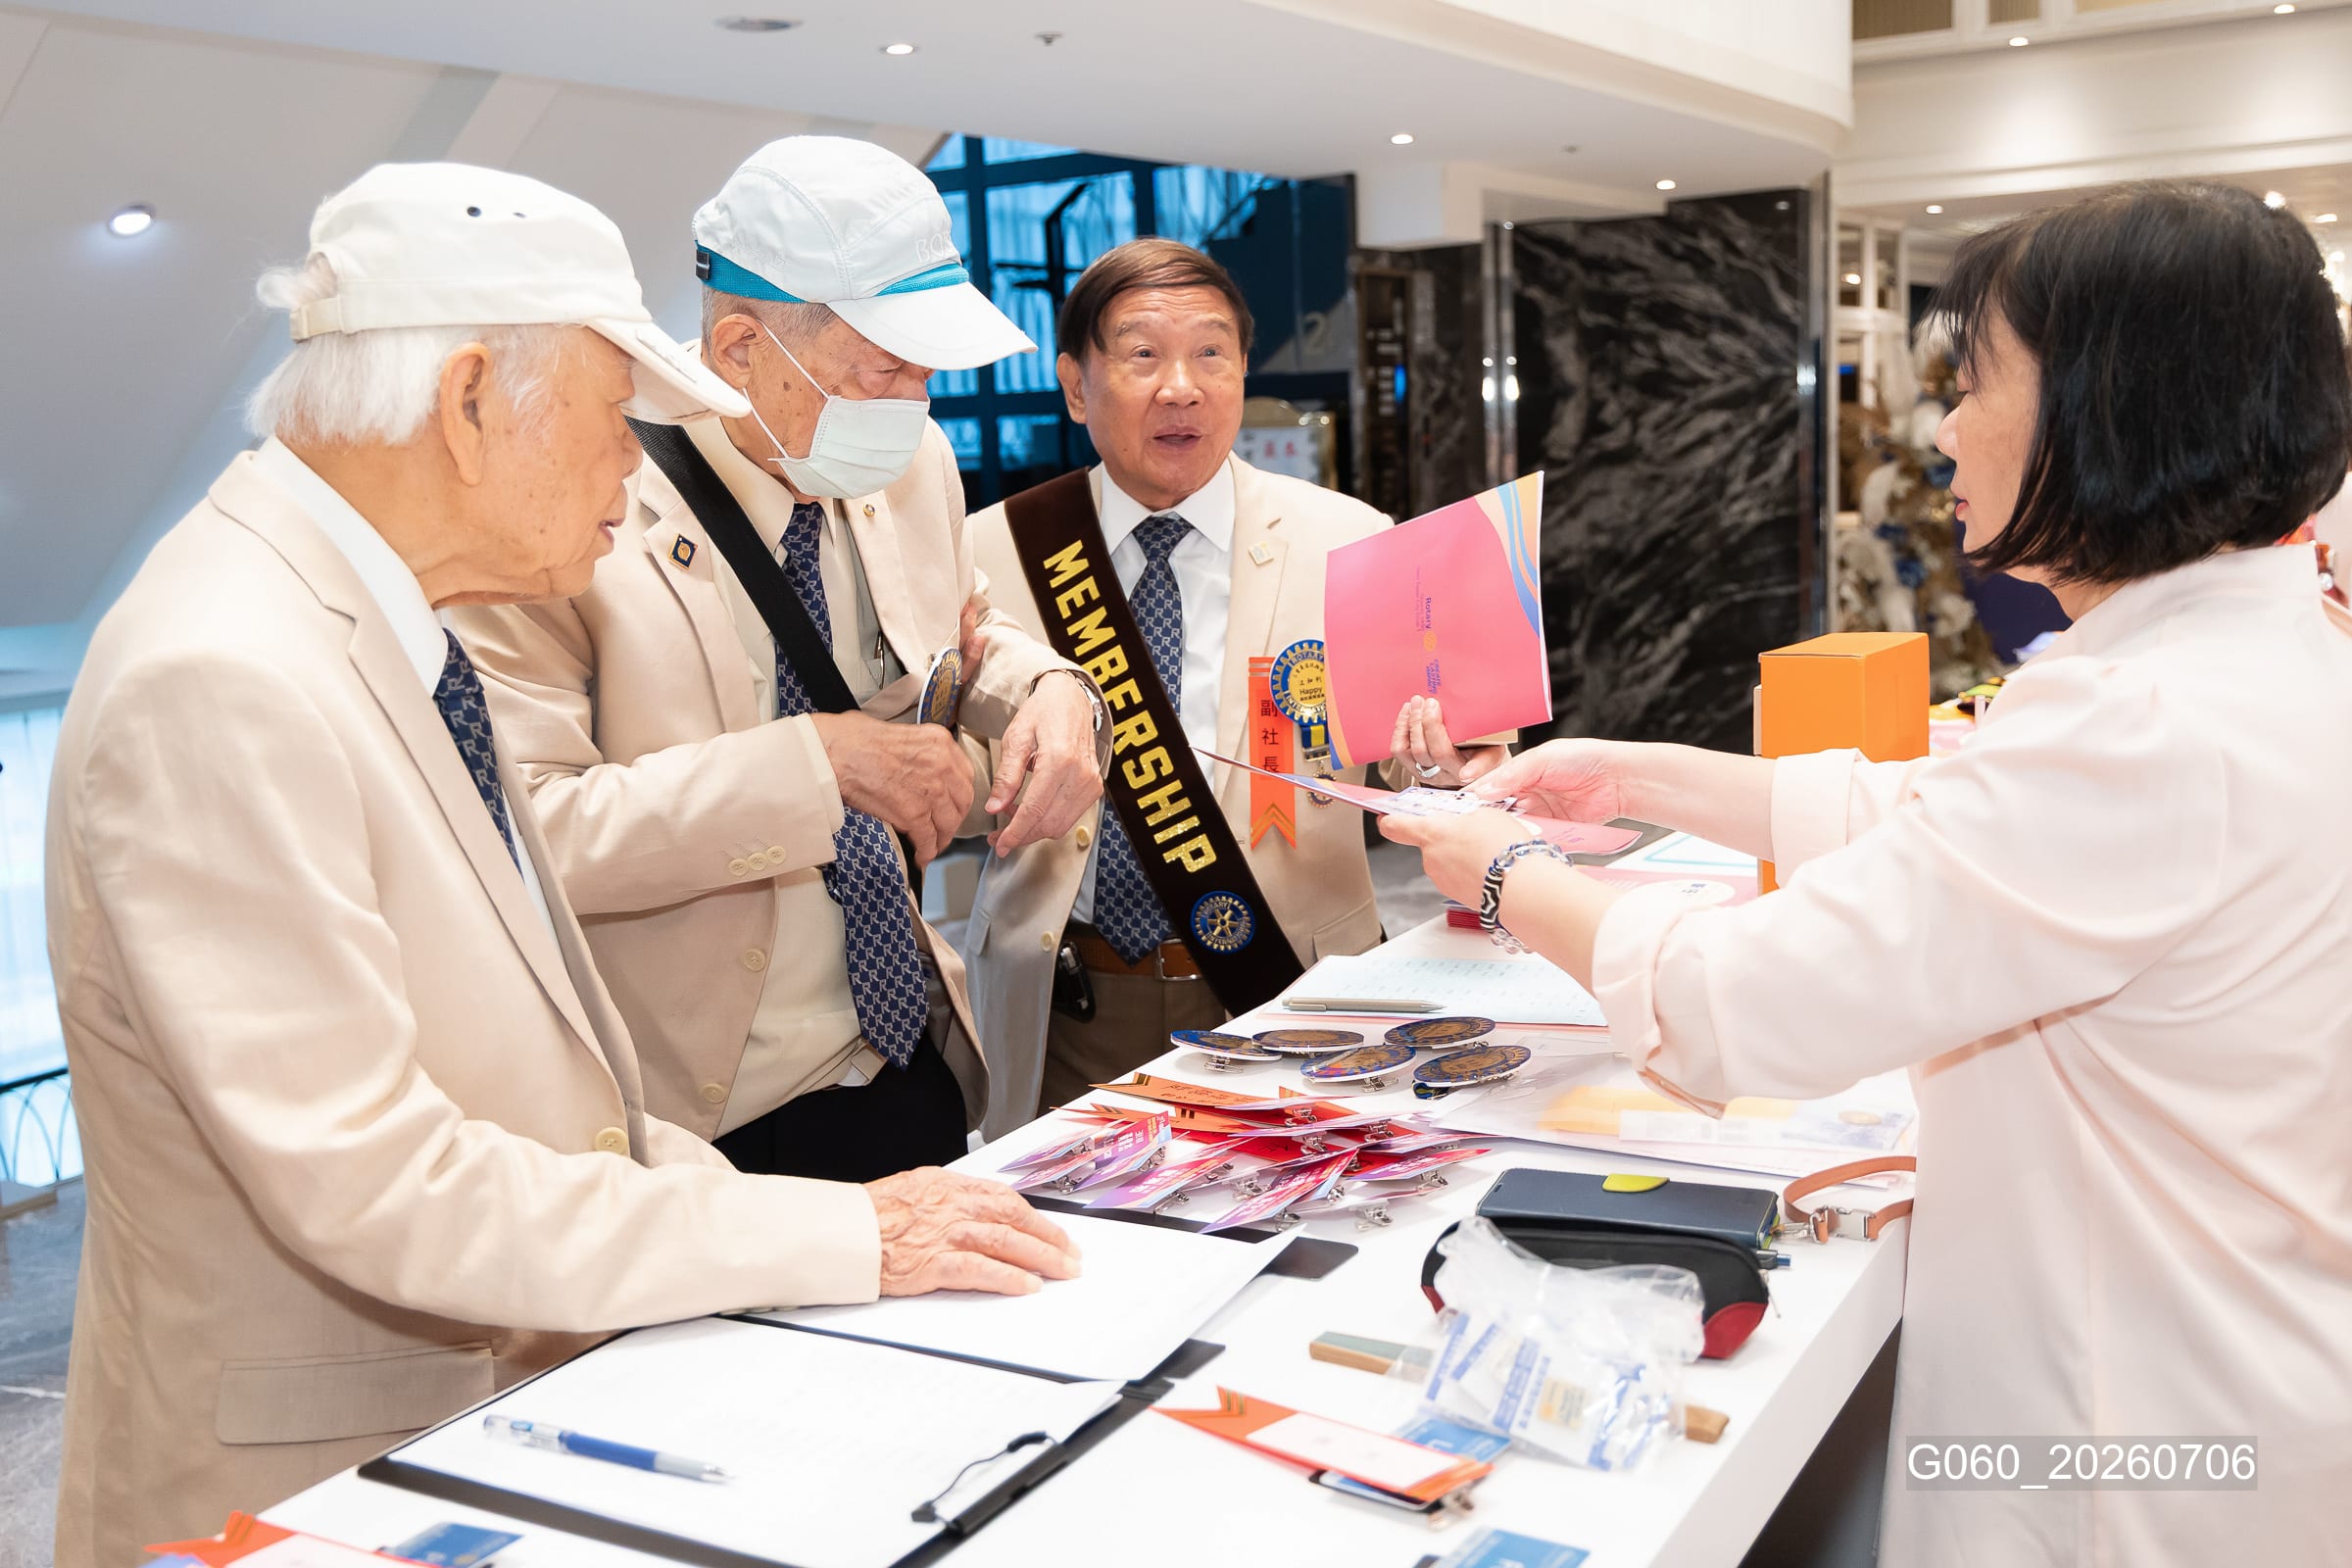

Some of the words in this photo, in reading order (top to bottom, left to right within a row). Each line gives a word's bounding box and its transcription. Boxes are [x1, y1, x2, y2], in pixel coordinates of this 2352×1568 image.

[1043, 539, 1217, 873] MEMBERSHIP
[1299, 687, 1322, 696] Happy
[1260, 699, 1279, 773] 副社長
